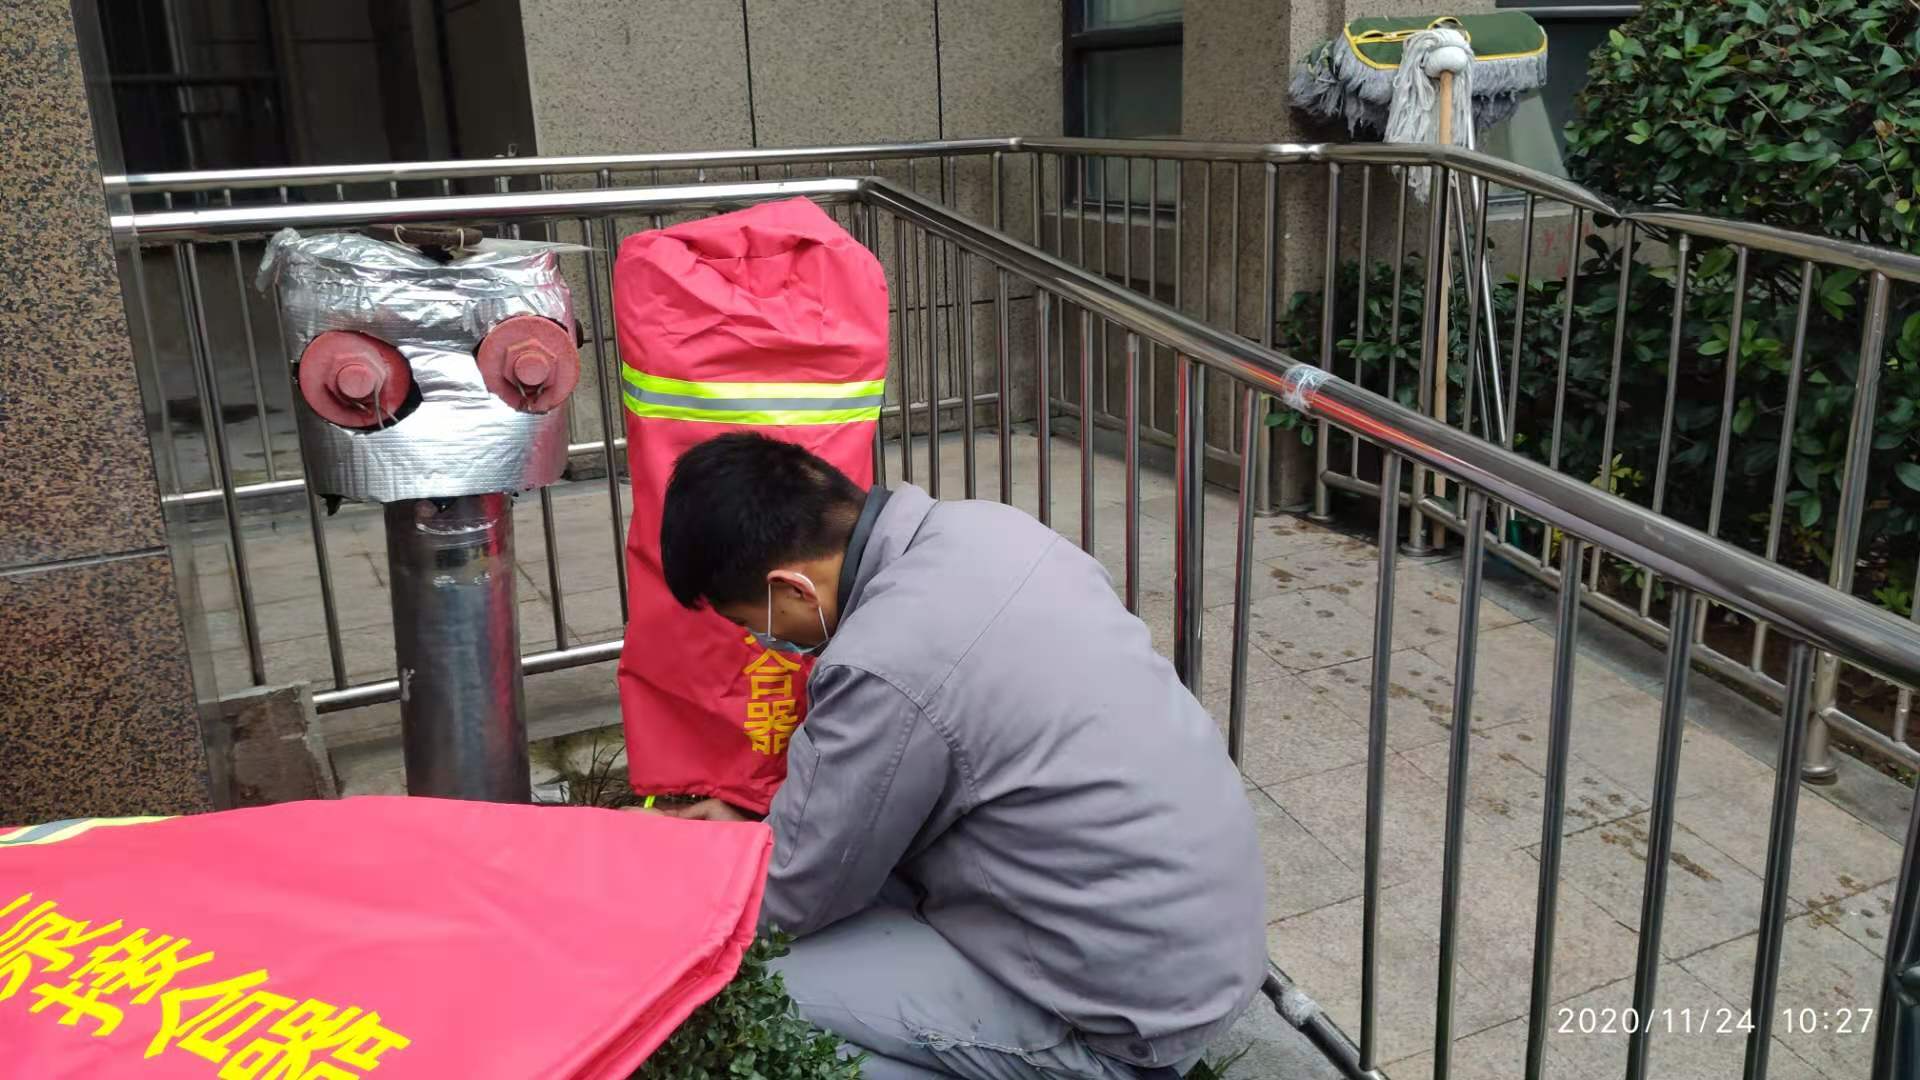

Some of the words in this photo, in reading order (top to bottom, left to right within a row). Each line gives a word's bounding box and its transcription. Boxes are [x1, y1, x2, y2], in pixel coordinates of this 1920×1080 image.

[743, 635, 801, 755] 合器
[0, 892, 411, 1080] 泵接合器
